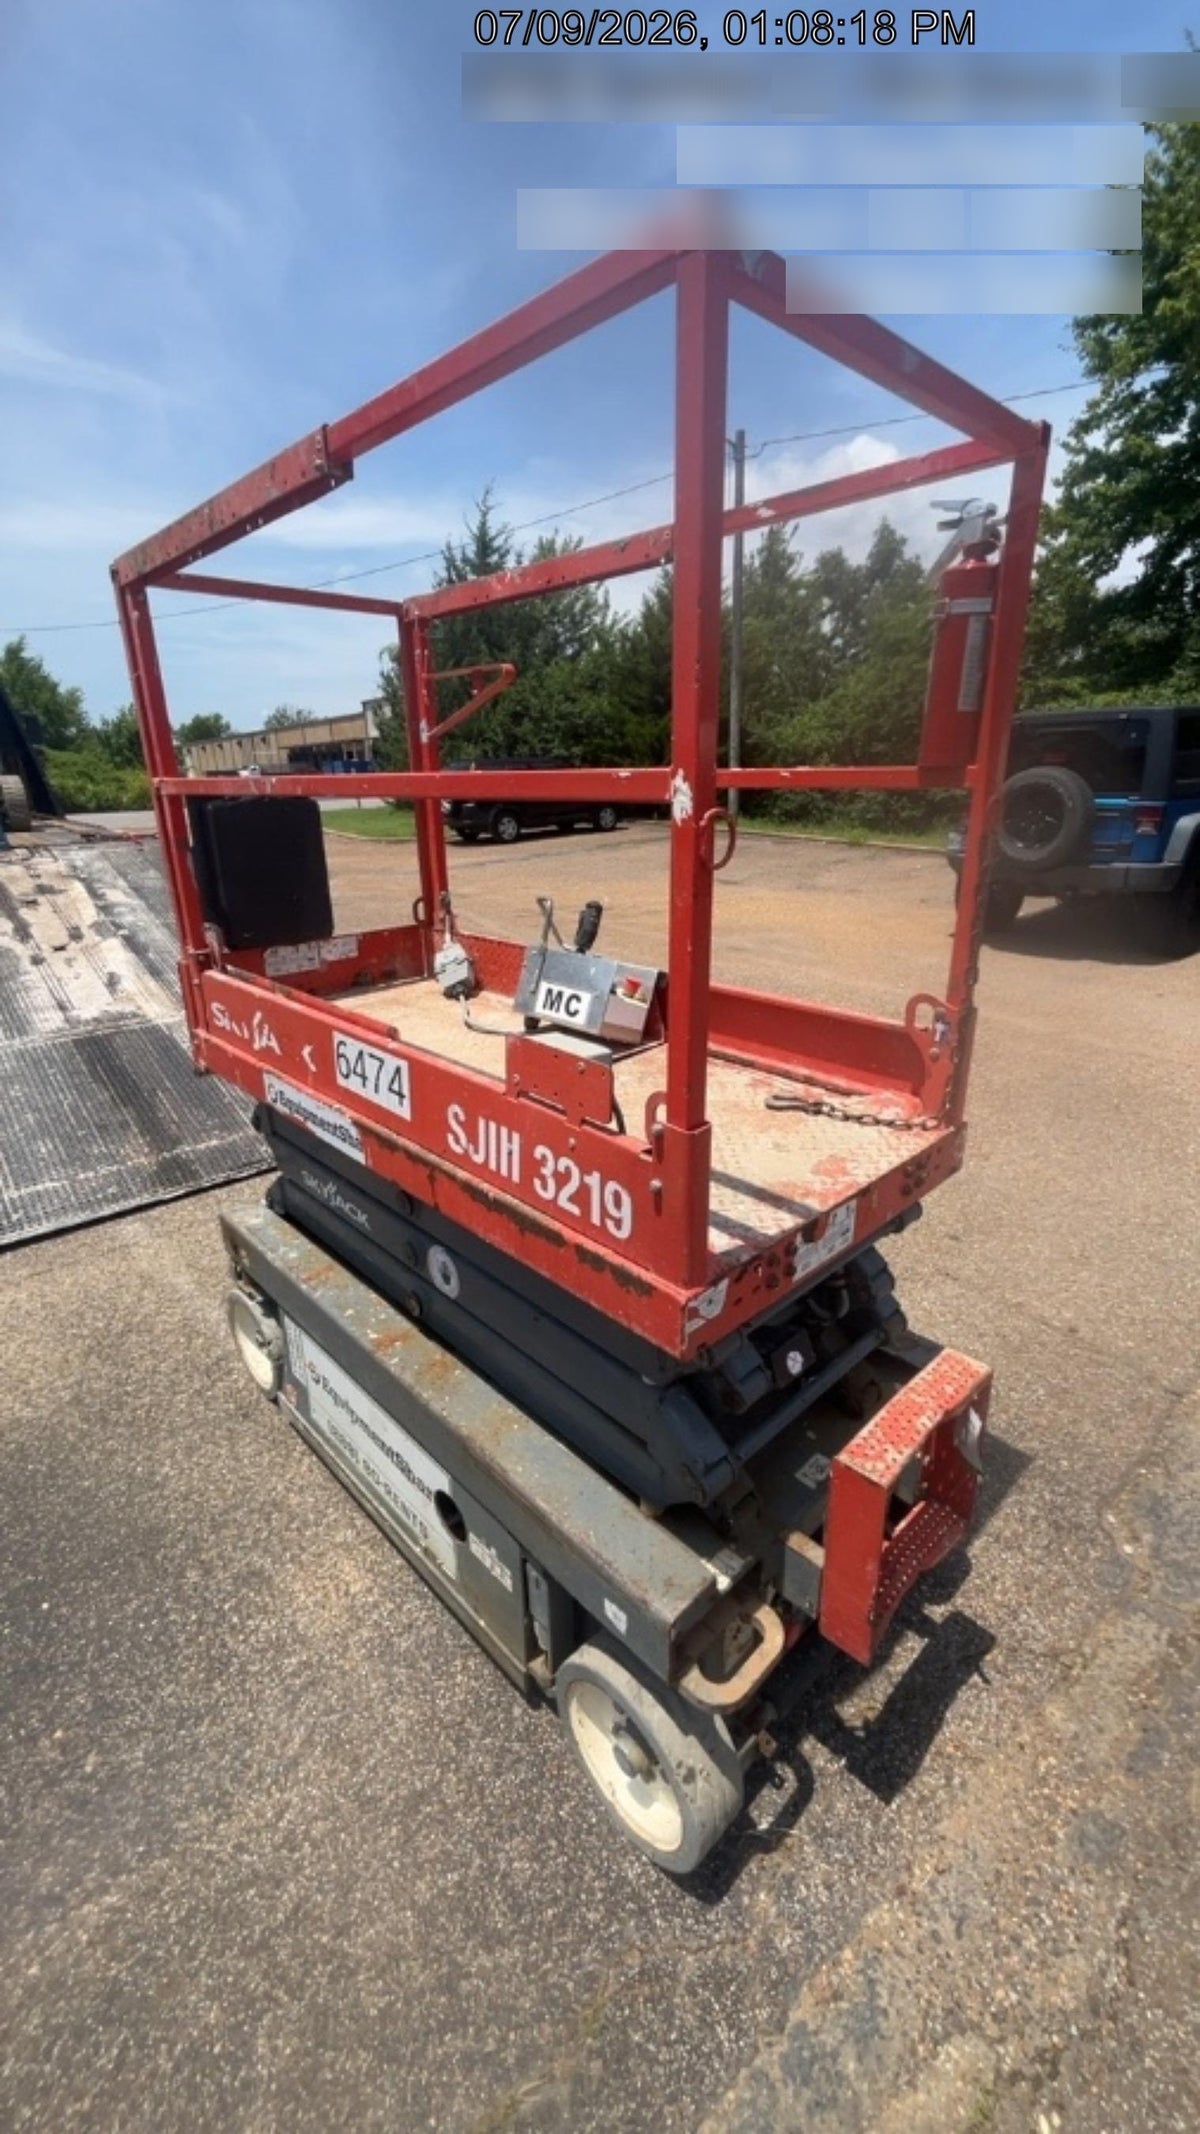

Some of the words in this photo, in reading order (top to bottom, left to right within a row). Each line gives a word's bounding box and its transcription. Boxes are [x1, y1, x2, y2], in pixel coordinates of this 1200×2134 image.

[542, 988, 583, 1018] MC
[335, 1040, 407, 1108] 6474
[532, 1144, 633, 1239] 3219
